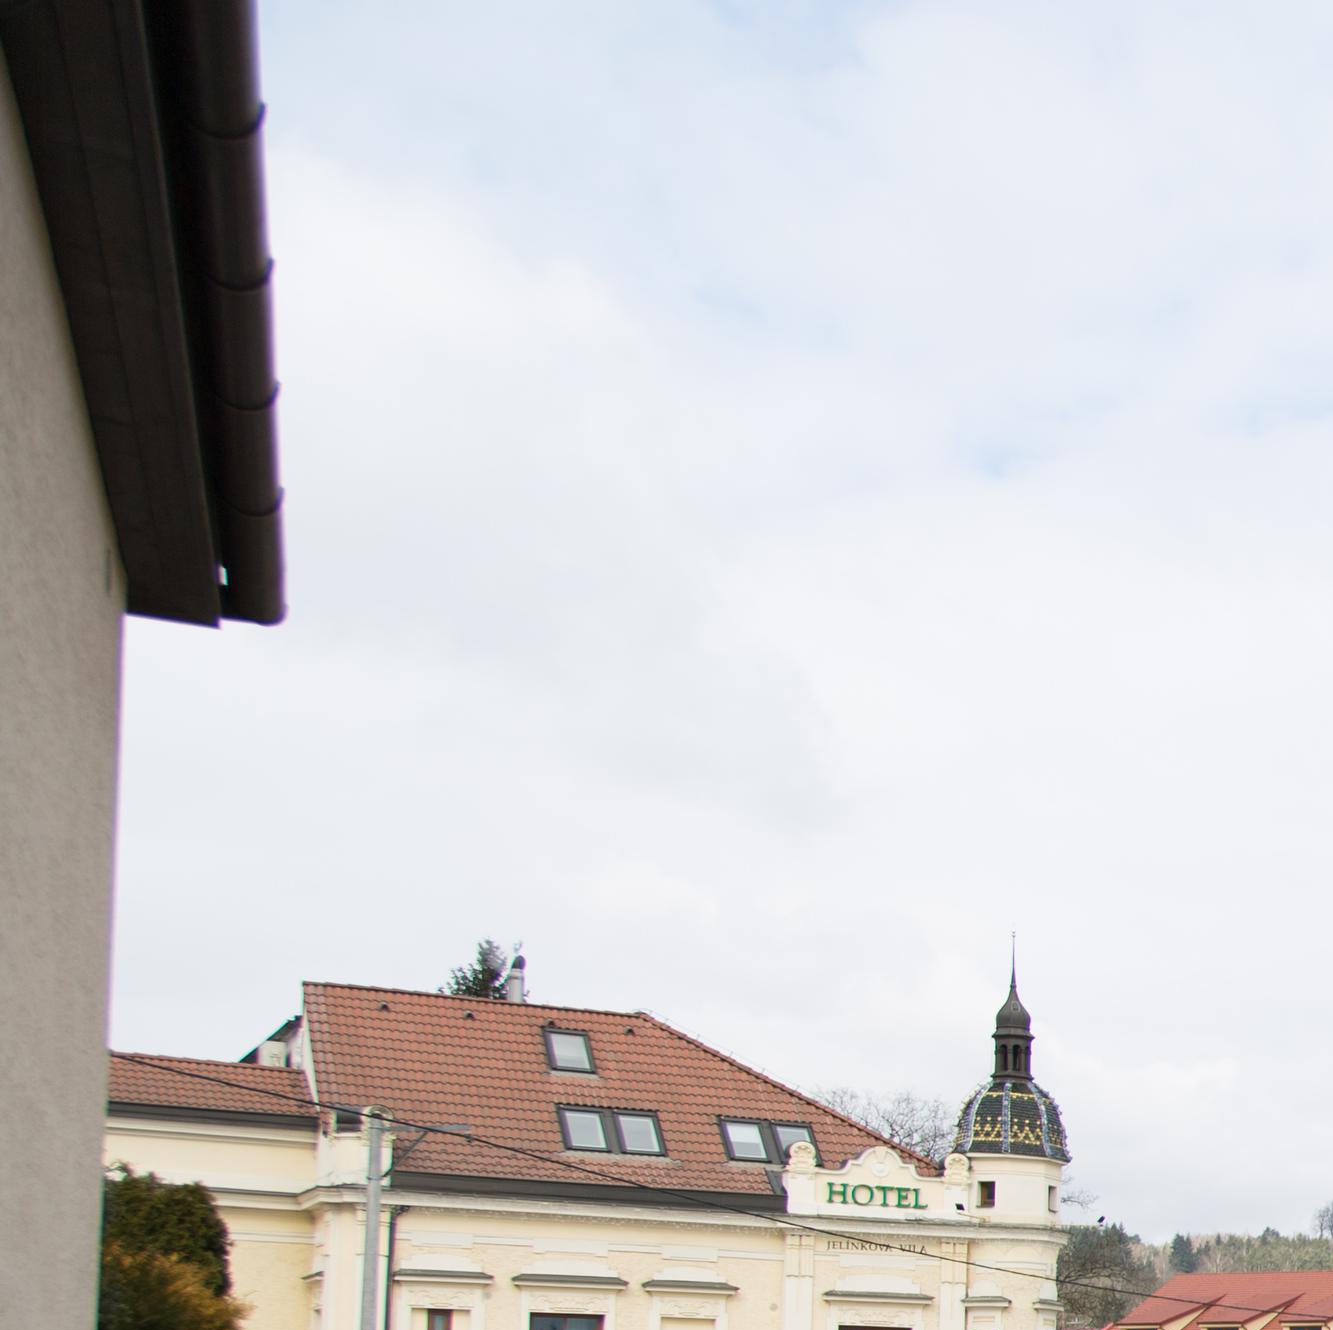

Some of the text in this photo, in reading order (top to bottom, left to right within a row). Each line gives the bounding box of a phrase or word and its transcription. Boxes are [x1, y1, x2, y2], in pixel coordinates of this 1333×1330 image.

[826, 1182, 928, 1209] HOTEL
[826, 1239, 928, 1255] JELÍNKOVA VILA
